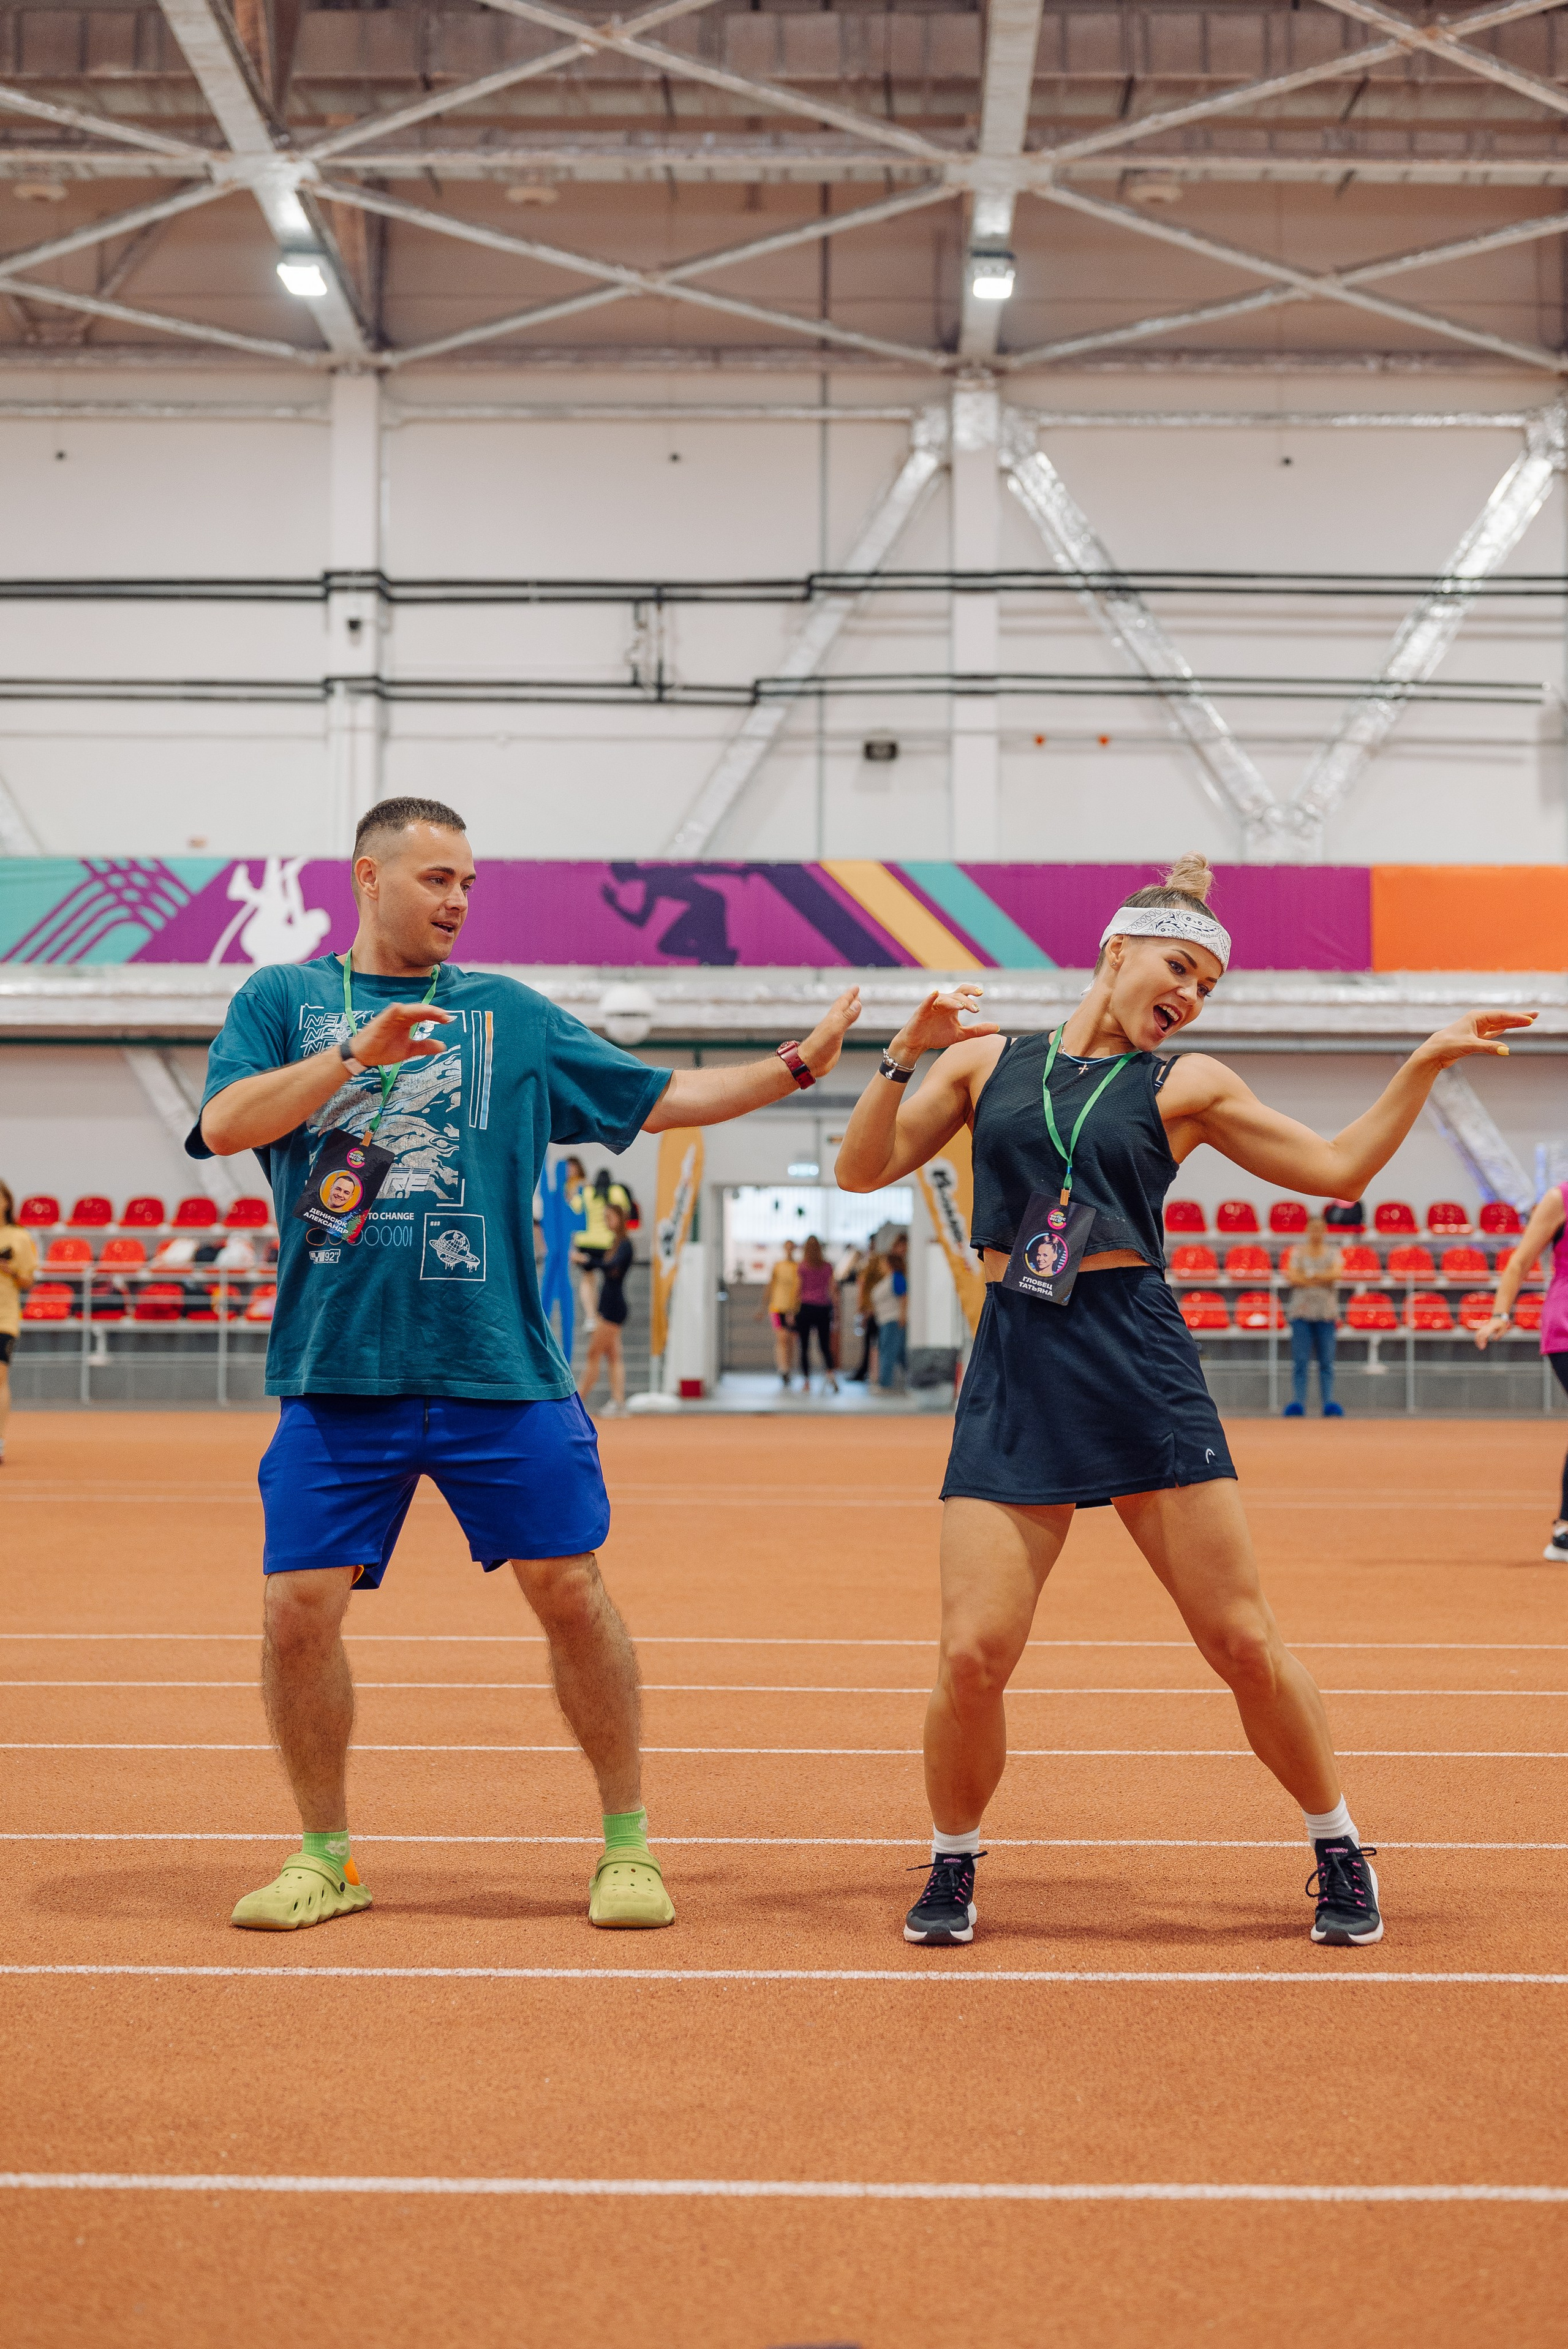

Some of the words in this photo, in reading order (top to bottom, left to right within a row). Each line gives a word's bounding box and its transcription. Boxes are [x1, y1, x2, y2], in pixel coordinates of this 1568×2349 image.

[303, 1212, 349, 1234] АЛЕКСАНДР
[309, 1208, 348, 1228] ДЕНИСЮК
[368, 1212, 379, 1220] TO
[380, 1212, 415, 1220] CHANGE
[1019, 1281, 1053, 1296] ТАТЬЯНА
[1022, 1276, 1053, 1290] ГЛОБЕЦ
